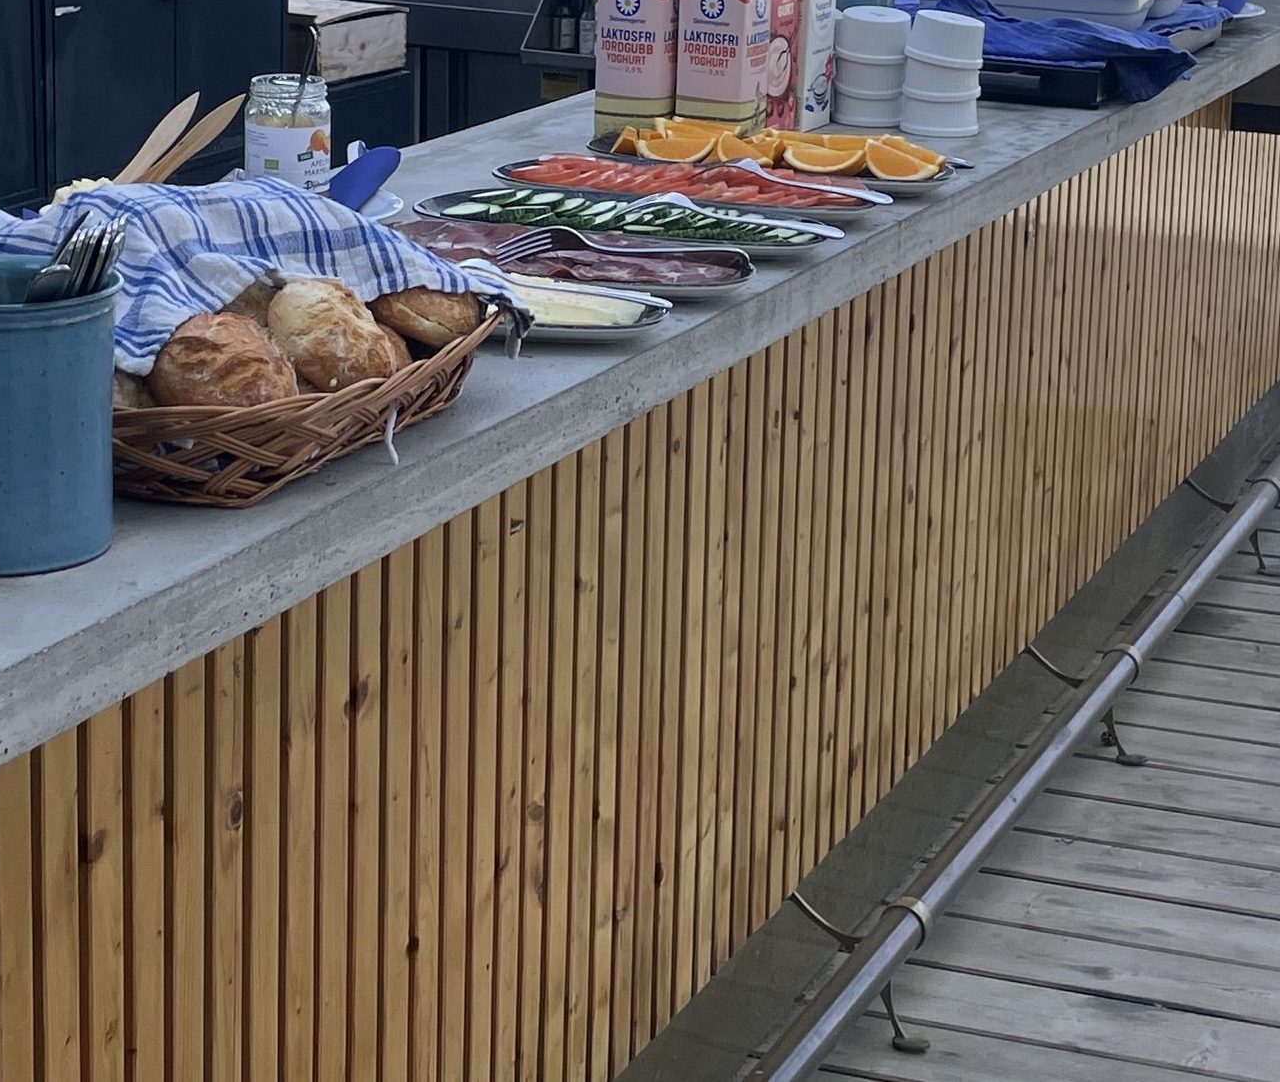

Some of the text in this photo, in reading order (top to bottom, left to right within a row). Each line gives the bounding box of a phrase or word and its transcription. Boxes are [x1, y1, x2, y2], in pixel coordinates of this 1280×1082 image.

[601, 26, 656, 43] LAKTOSFRI
[683, 29, 739, 47] LAKTOSFRI
[601, 39, 654, 55] JORDGUBB
[683, 43, 737, 58] JORDGUBB
[607, 51, 646, 66] YOGHURT
[689, 55, 730, 68] YOGHURT
